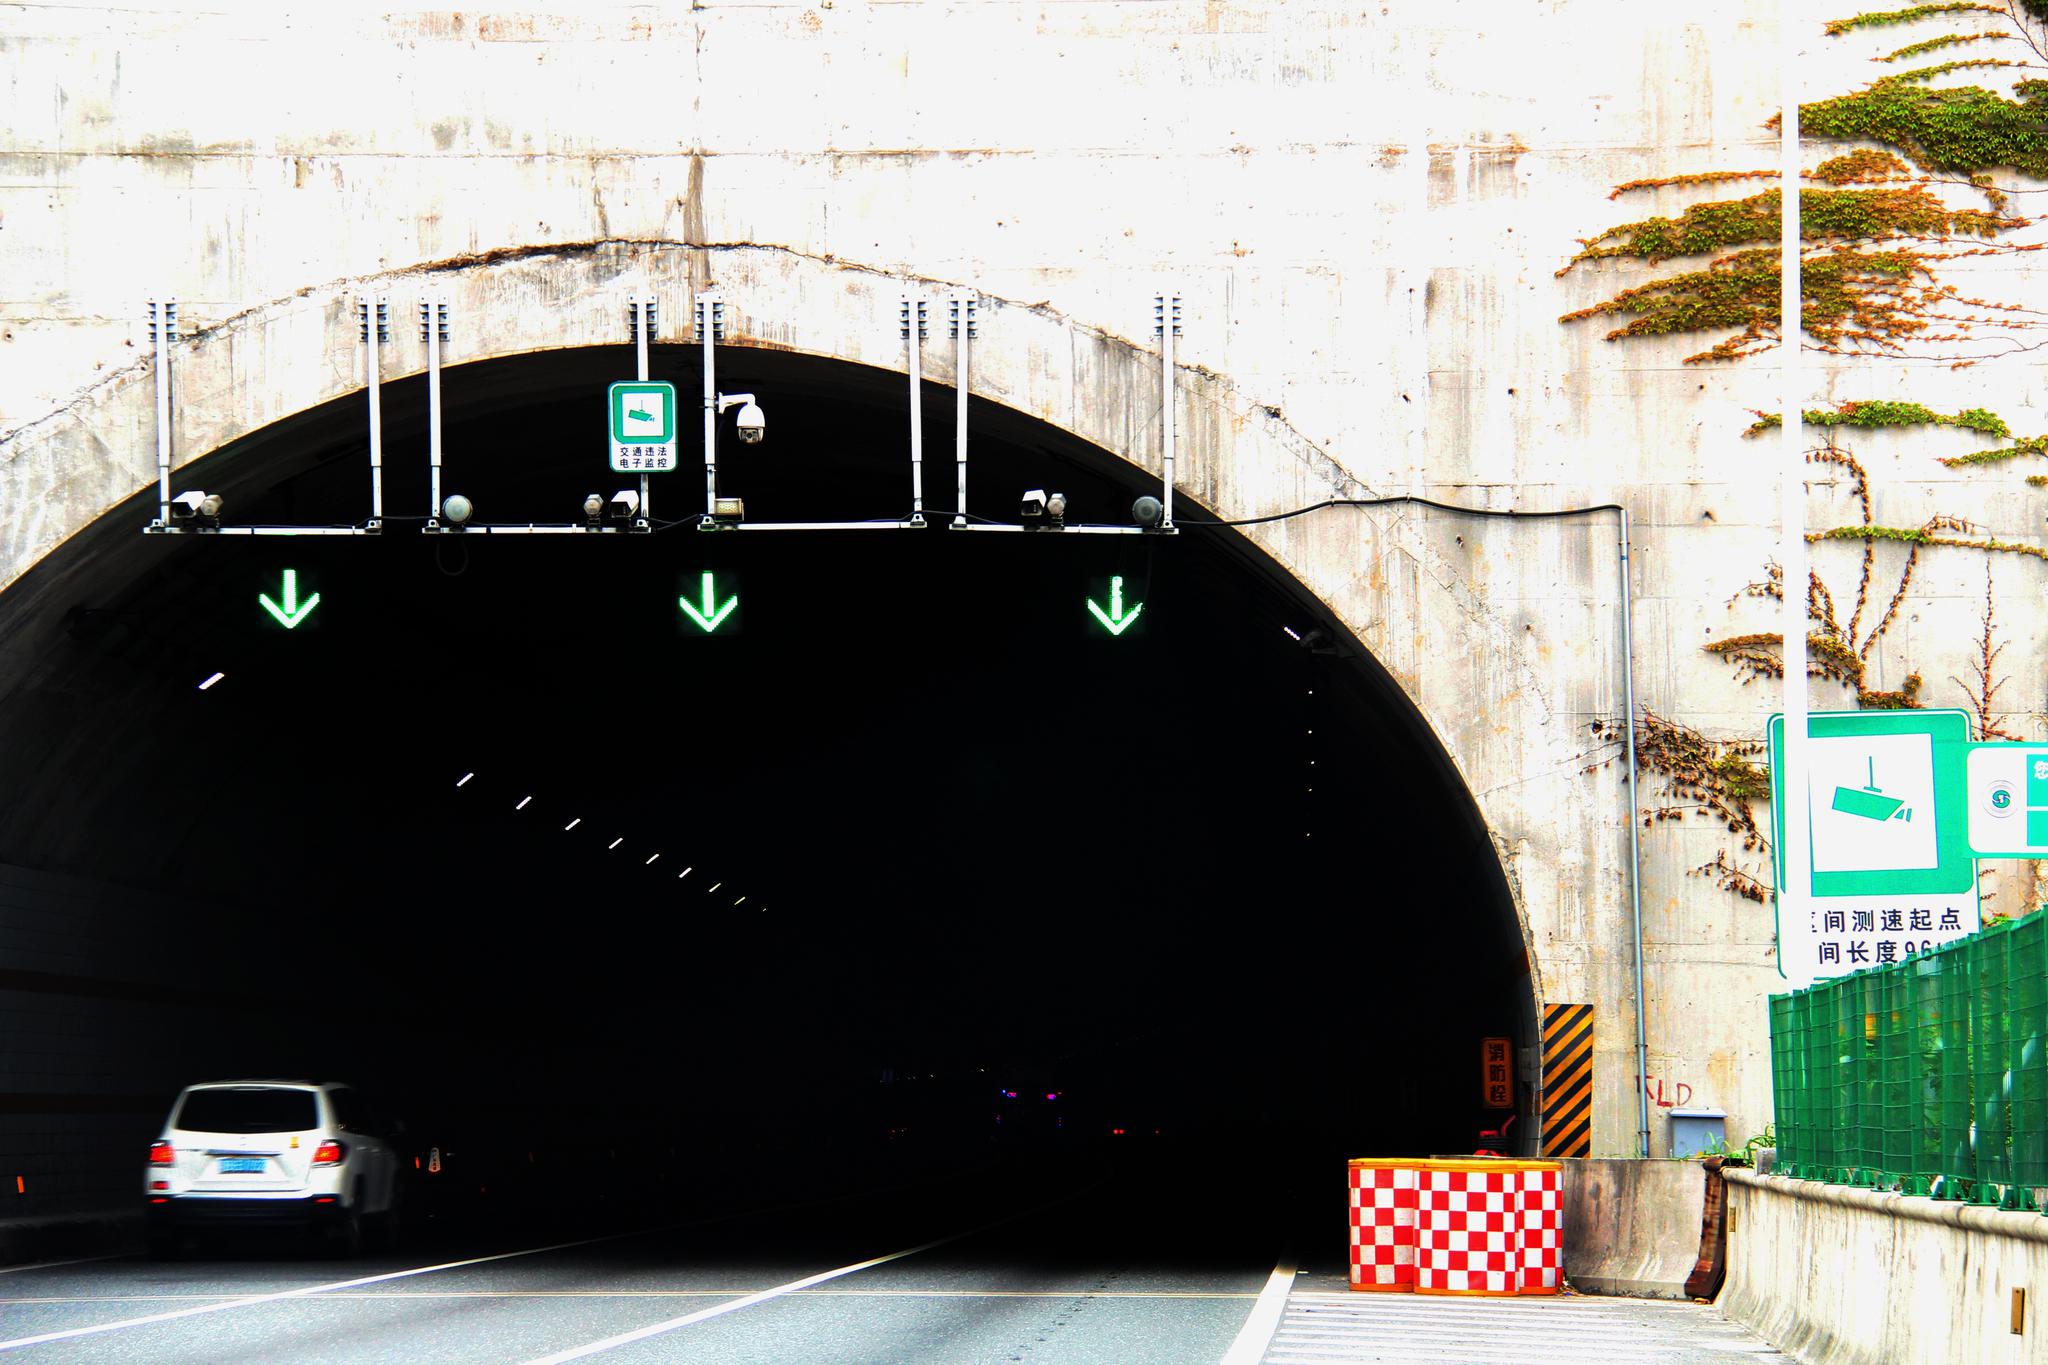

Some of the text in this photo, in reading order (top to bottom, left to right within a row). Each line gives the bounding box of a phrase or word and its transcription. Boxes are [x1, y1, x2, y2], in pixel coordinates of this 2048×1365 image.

[619, 446, 668, 457] 交通违法
[619, 458, 668, 468] 电子监控
[1488, 1043, 1507, 1102] 消防栓
